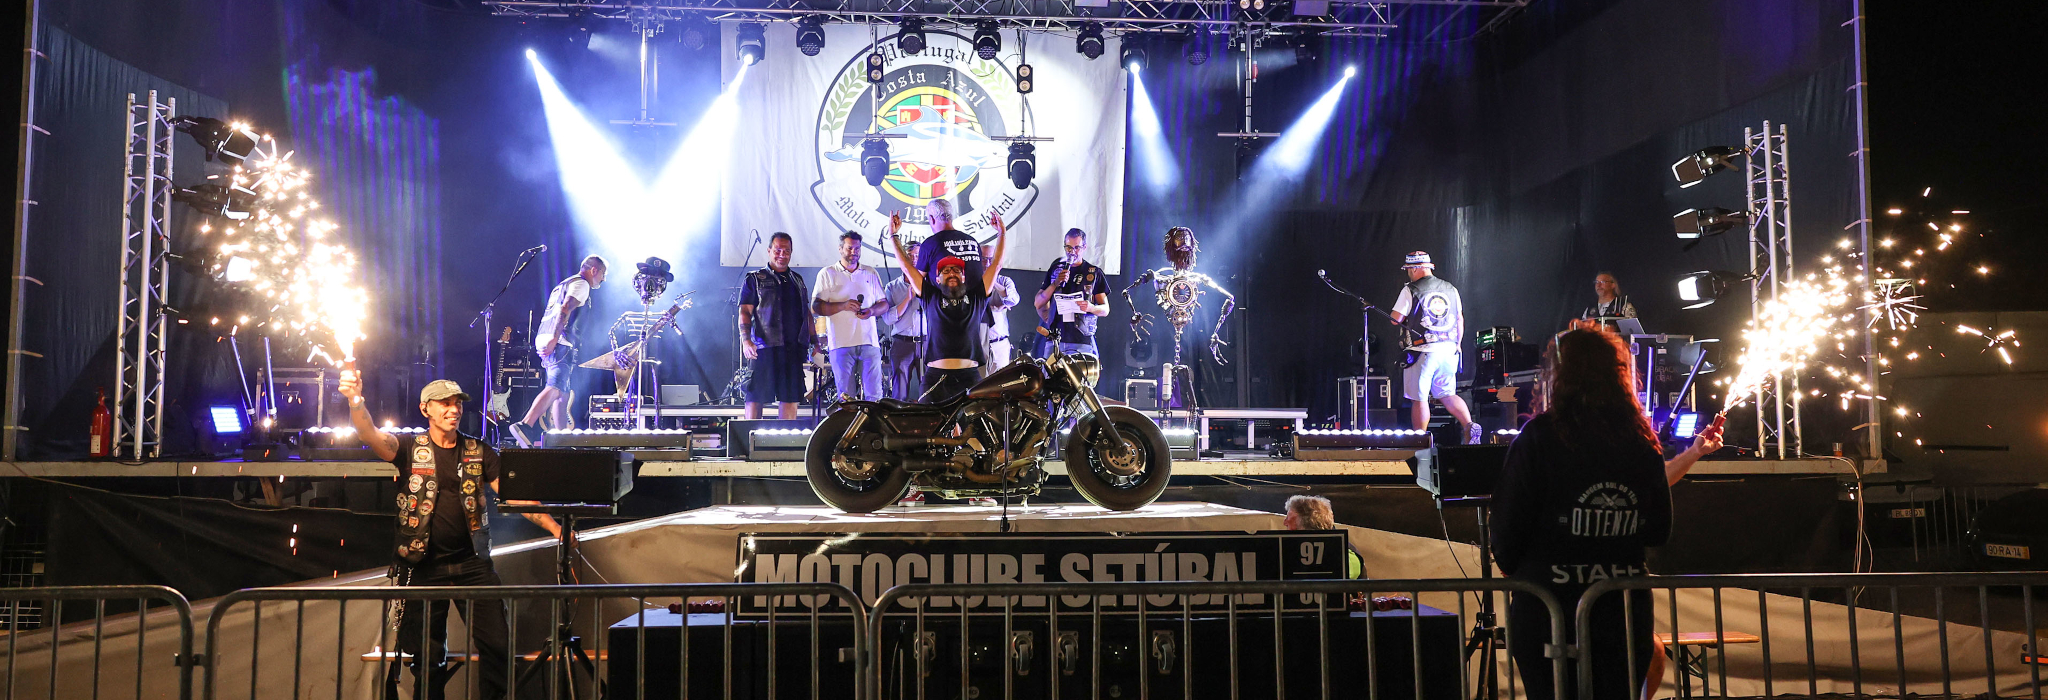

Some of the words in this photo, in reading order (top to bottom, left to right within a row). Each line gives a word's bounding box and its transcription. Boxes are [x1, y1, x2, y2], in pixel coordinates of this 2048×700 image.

[940, 70, 986, 107] Azul
[1571, 507, 1639, 537] OITENTA
[1299, 541, 1325, 566] 97
[753, 548, 1046, 608] MOTOCLUBE
[1059, 543, 1265, 608] SETÚBAL
